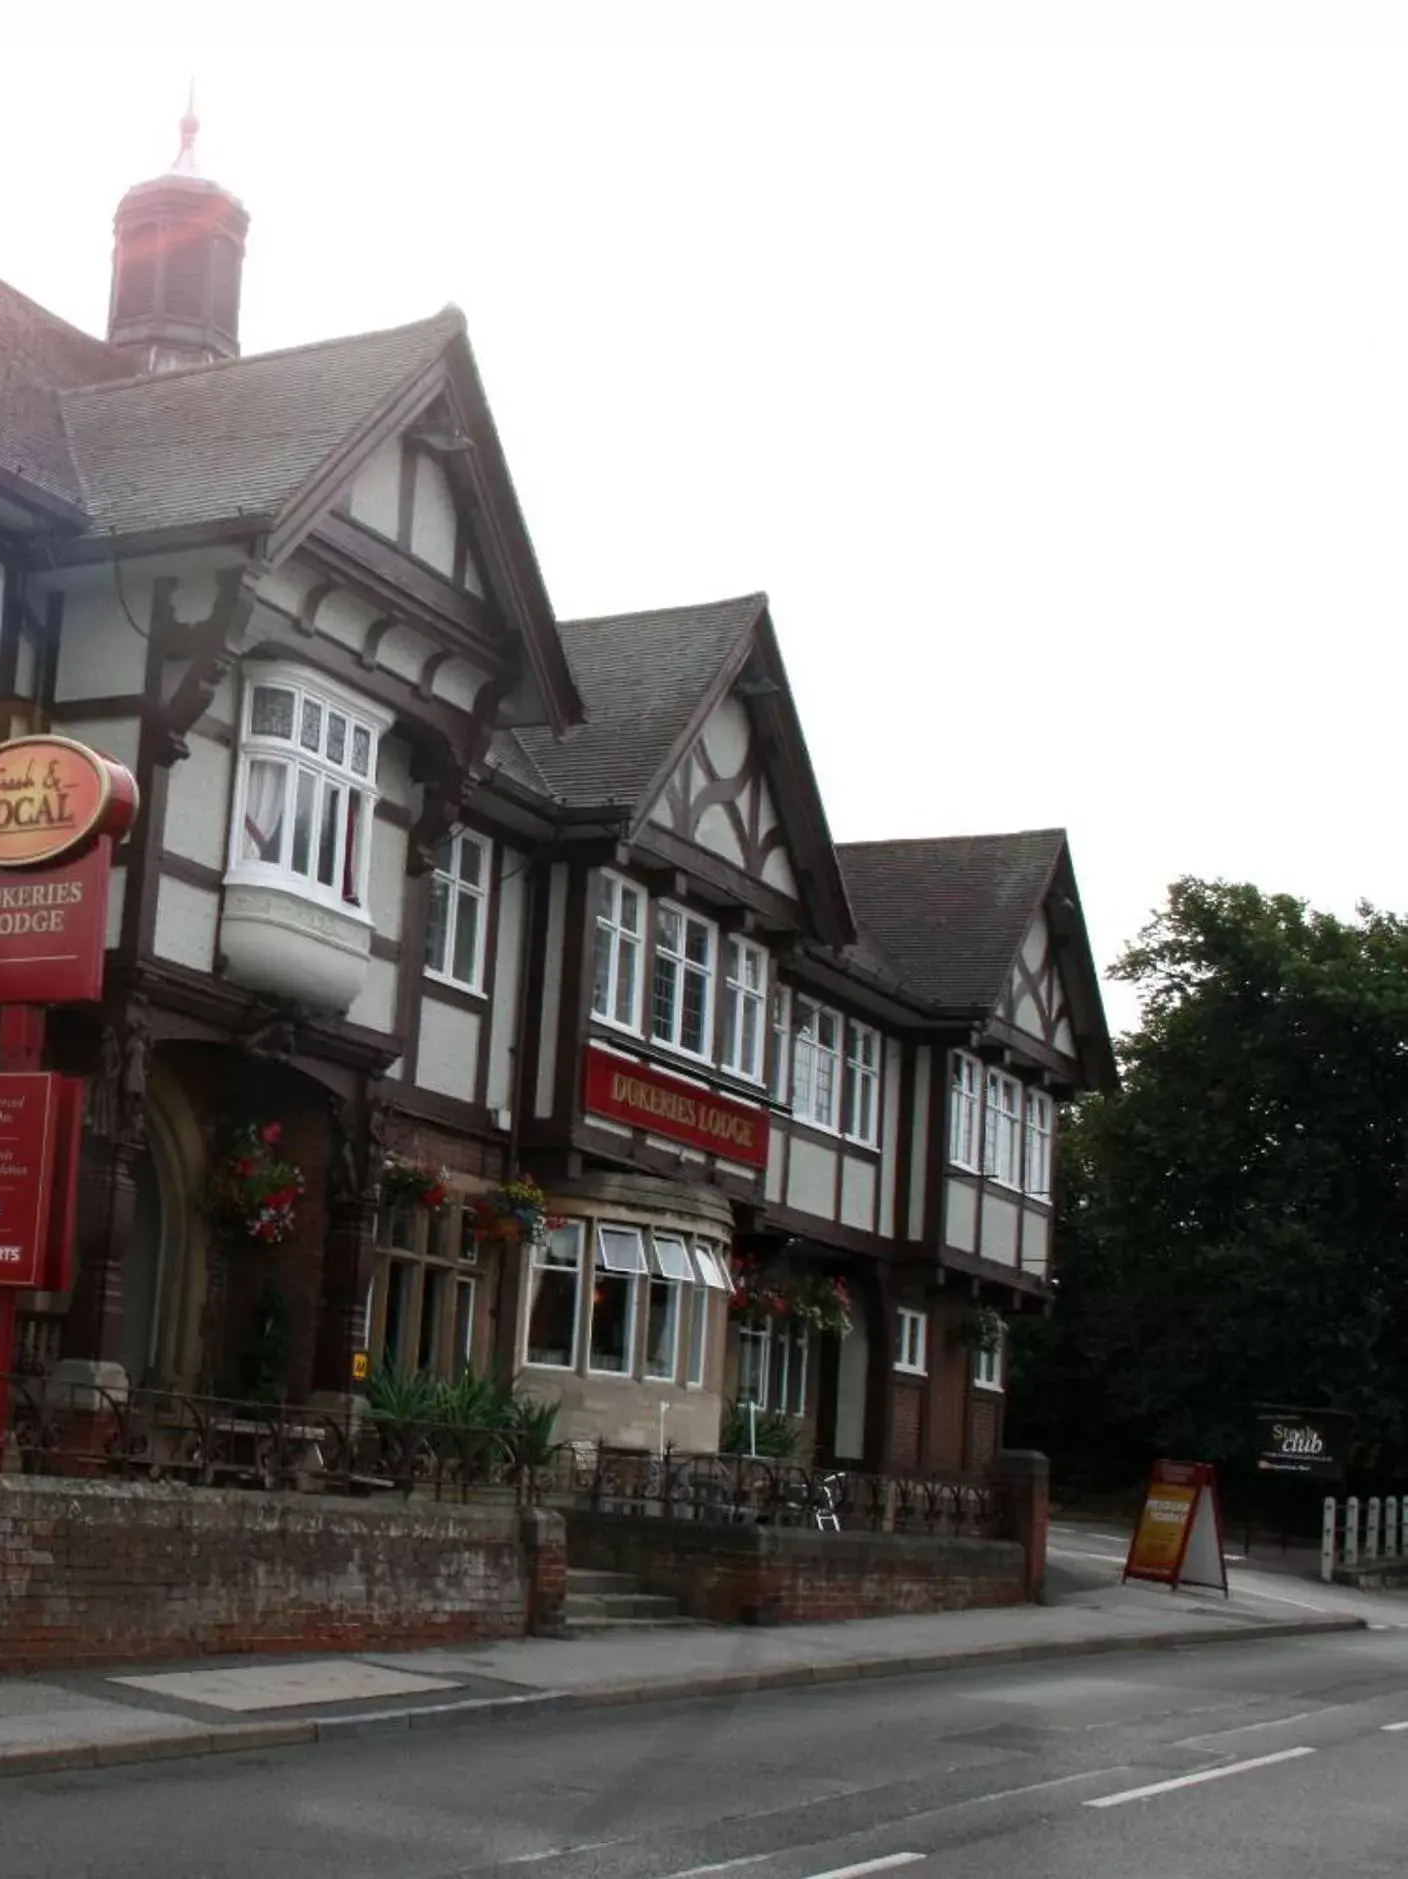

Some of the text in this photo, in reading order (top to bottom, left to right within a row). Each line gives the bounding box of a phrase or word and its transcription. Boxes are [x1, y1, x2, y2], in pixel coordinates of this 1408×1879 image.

[43, 760, 61, 793] &
[612, 1072, 754, 1148] DUKERIES LODGE
[1282, 1432, 1323, 1454] club
